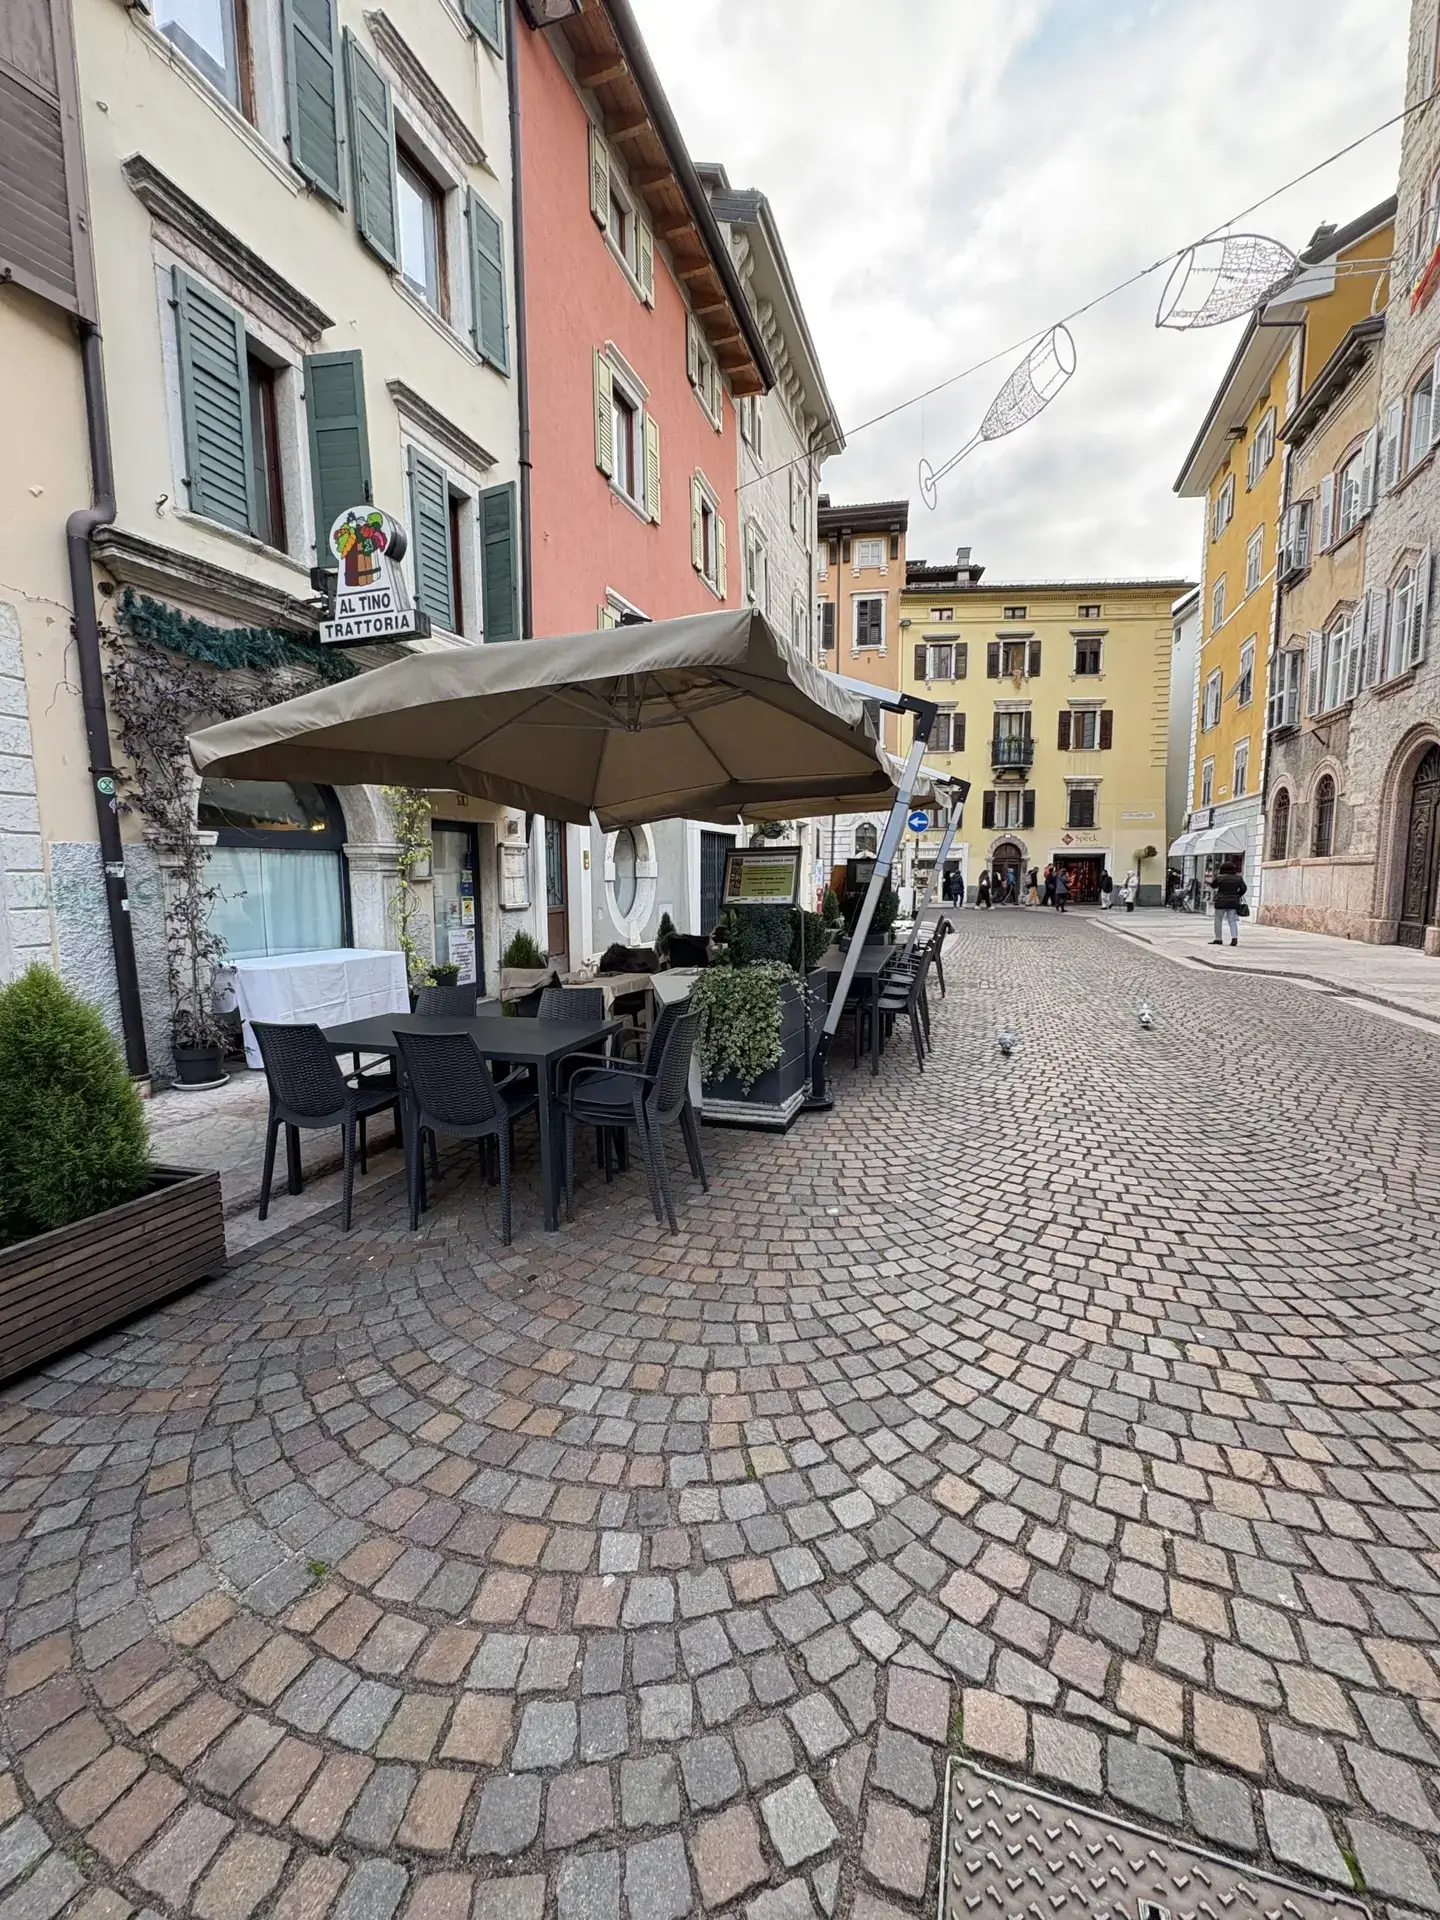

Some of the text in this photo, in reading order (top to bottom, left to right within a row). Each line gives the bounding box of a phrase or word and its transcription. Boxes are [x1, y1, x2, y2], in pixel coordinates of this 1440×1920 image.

[340, 593, 391, 614] AL TINO
[325, 614, 410, 638] TRATTORIA
